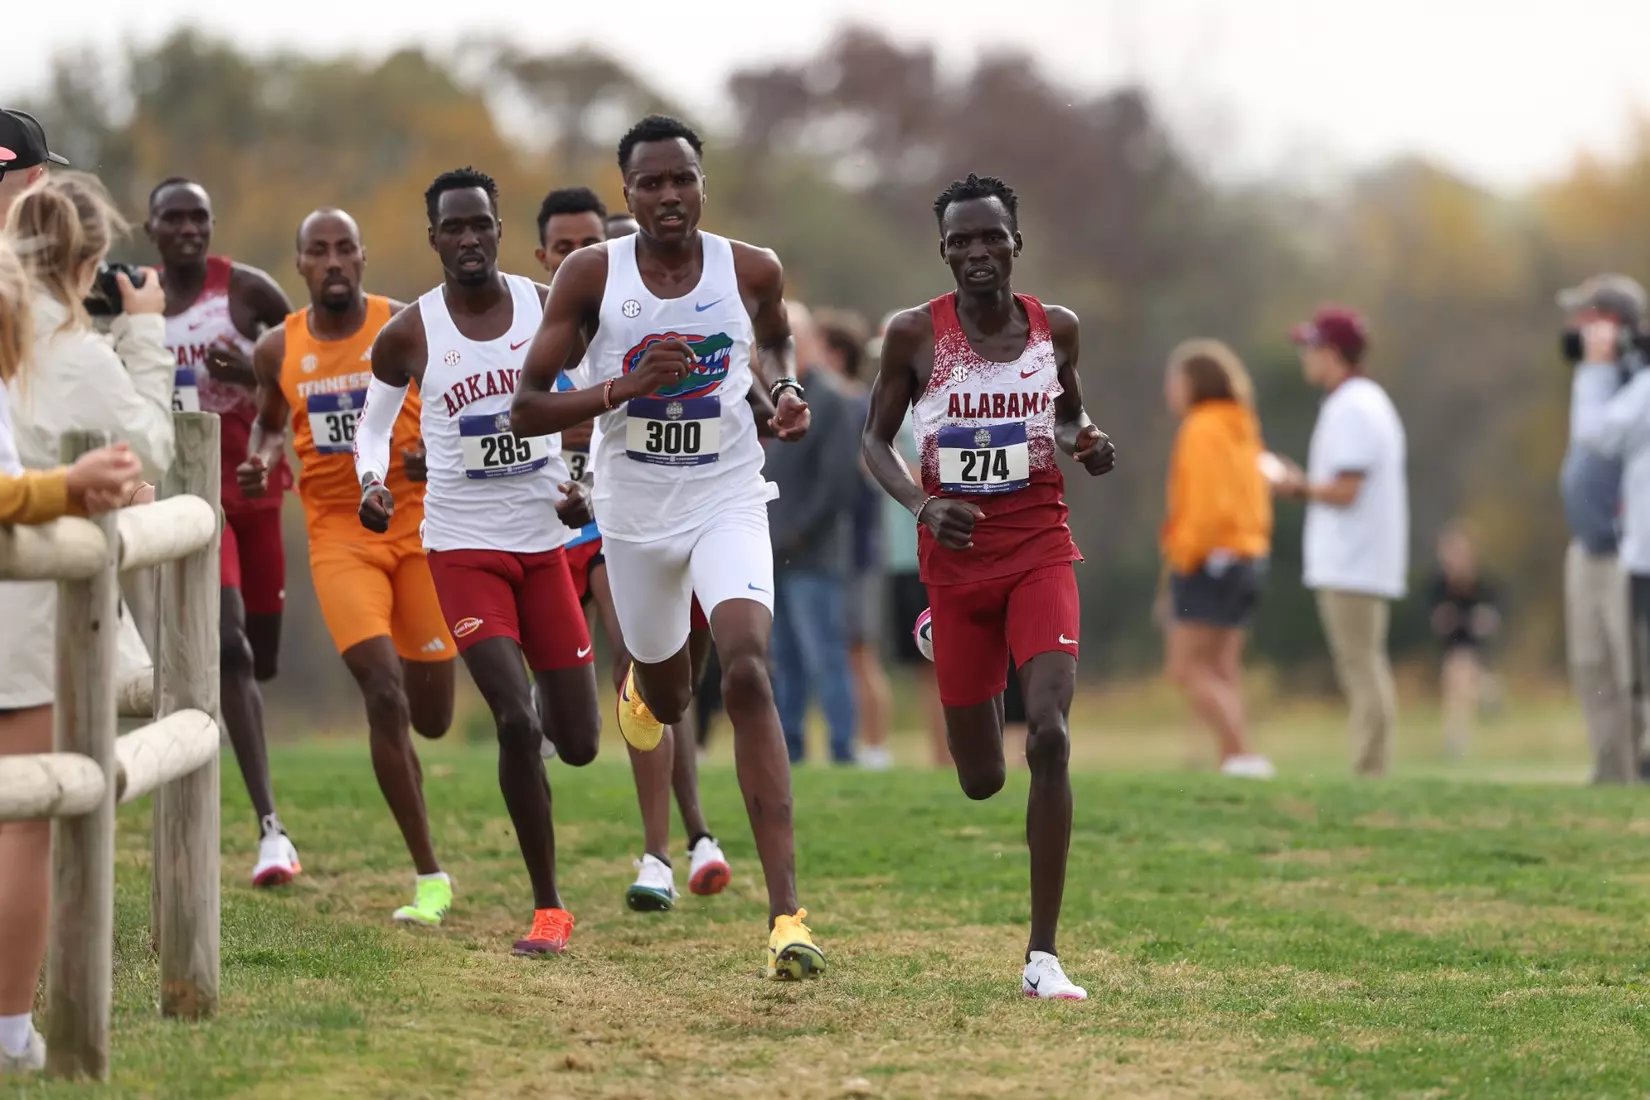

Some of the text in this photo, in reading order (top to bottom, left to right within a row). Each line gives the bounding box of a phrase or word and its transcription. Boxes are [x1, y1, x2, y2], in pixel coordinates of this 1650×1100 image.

[623, 300, 641, 317] SEC
[444, 351, 461, 366] SEC
[952, 368, 968, 382] SEC
[326, 411, 363, 445] 36
[646, 421, 701, 454] 300
[481, 435, 531, 467] 285
[960, 448, 1010, 482] 274
